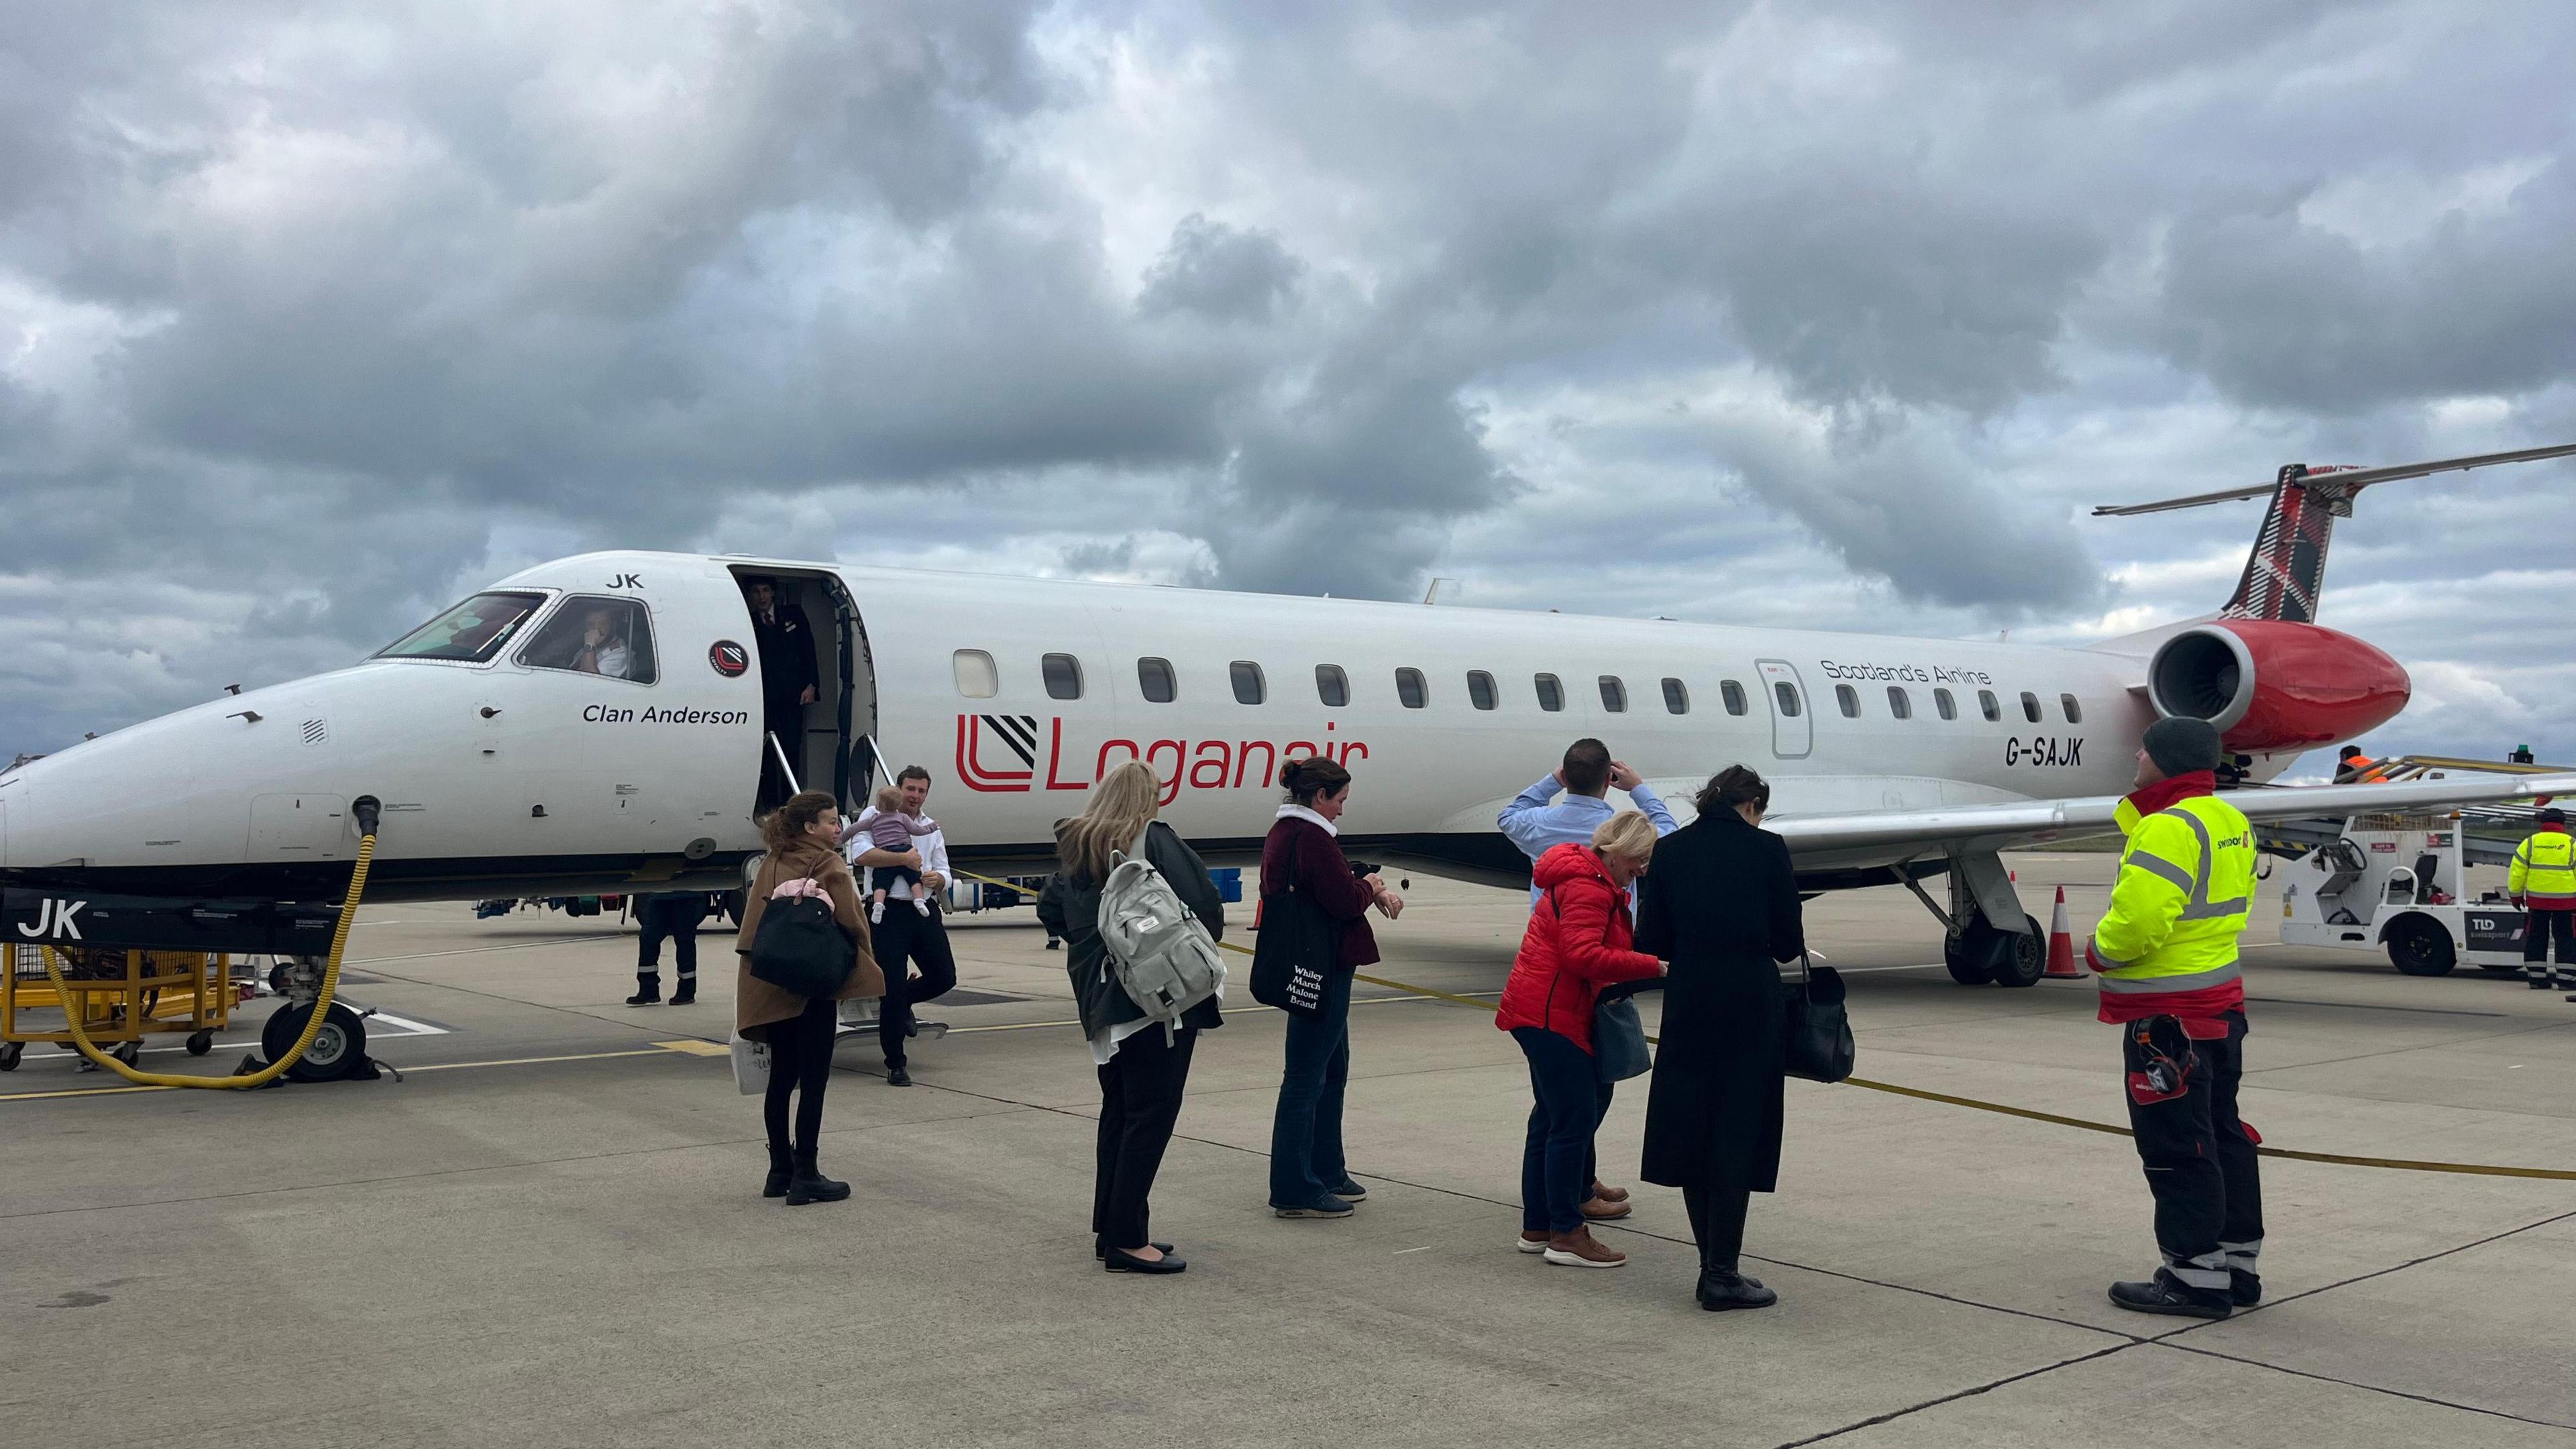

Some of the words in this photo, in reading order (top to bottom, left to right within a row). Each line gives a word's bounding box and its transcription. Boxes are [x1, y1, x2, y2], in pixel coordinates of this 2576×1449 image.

[605, 574, 645, 588] JK
[1820, 660, 1929, 682] Scotland's
[1933, 665, 1992, 685] Airline
[583, 704, 633, 722] Clan
[641, 706, 748, 724] Anderson
[2006, 737, 2084, 766] G-SAJK
[17, 898, 87, 939] JK
[2472, 918, 2495, 930] TLD
[1295, 965, 1324, 981] Whiley
[1293, 975, 1320, 991] March
[1286, 983, 1319, 1000] Malone
[1290, 995, 1316, 1010] Brand
